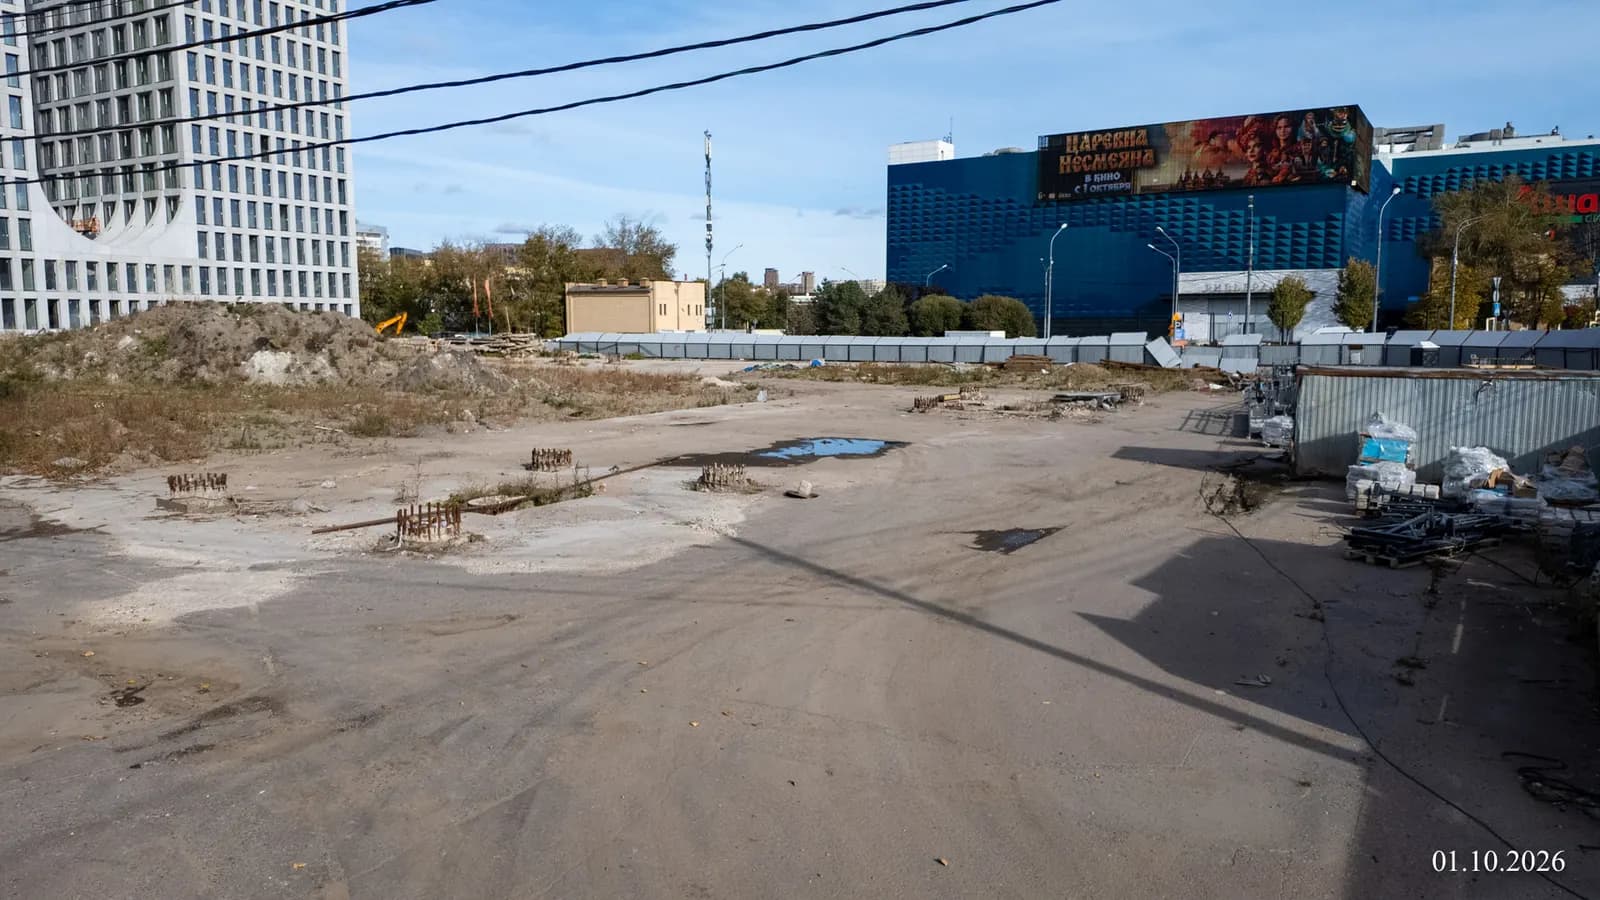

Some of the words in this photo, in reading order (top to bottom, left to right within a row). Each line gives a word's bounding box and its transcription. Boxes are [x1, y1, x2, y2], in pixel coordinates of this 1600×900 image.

[1066, 129, 1147, 153] ЦАРЕВНА
[1060, 149, 1154, 174] НЕСМЕЯНА
[1085, 174, 1092, 183] В
[1094, 171, 1121, 183] КИНО
[1083, 183, 1088, 193] 1
[1090, 182, 1132, 193] ОКТЯБРЯ
